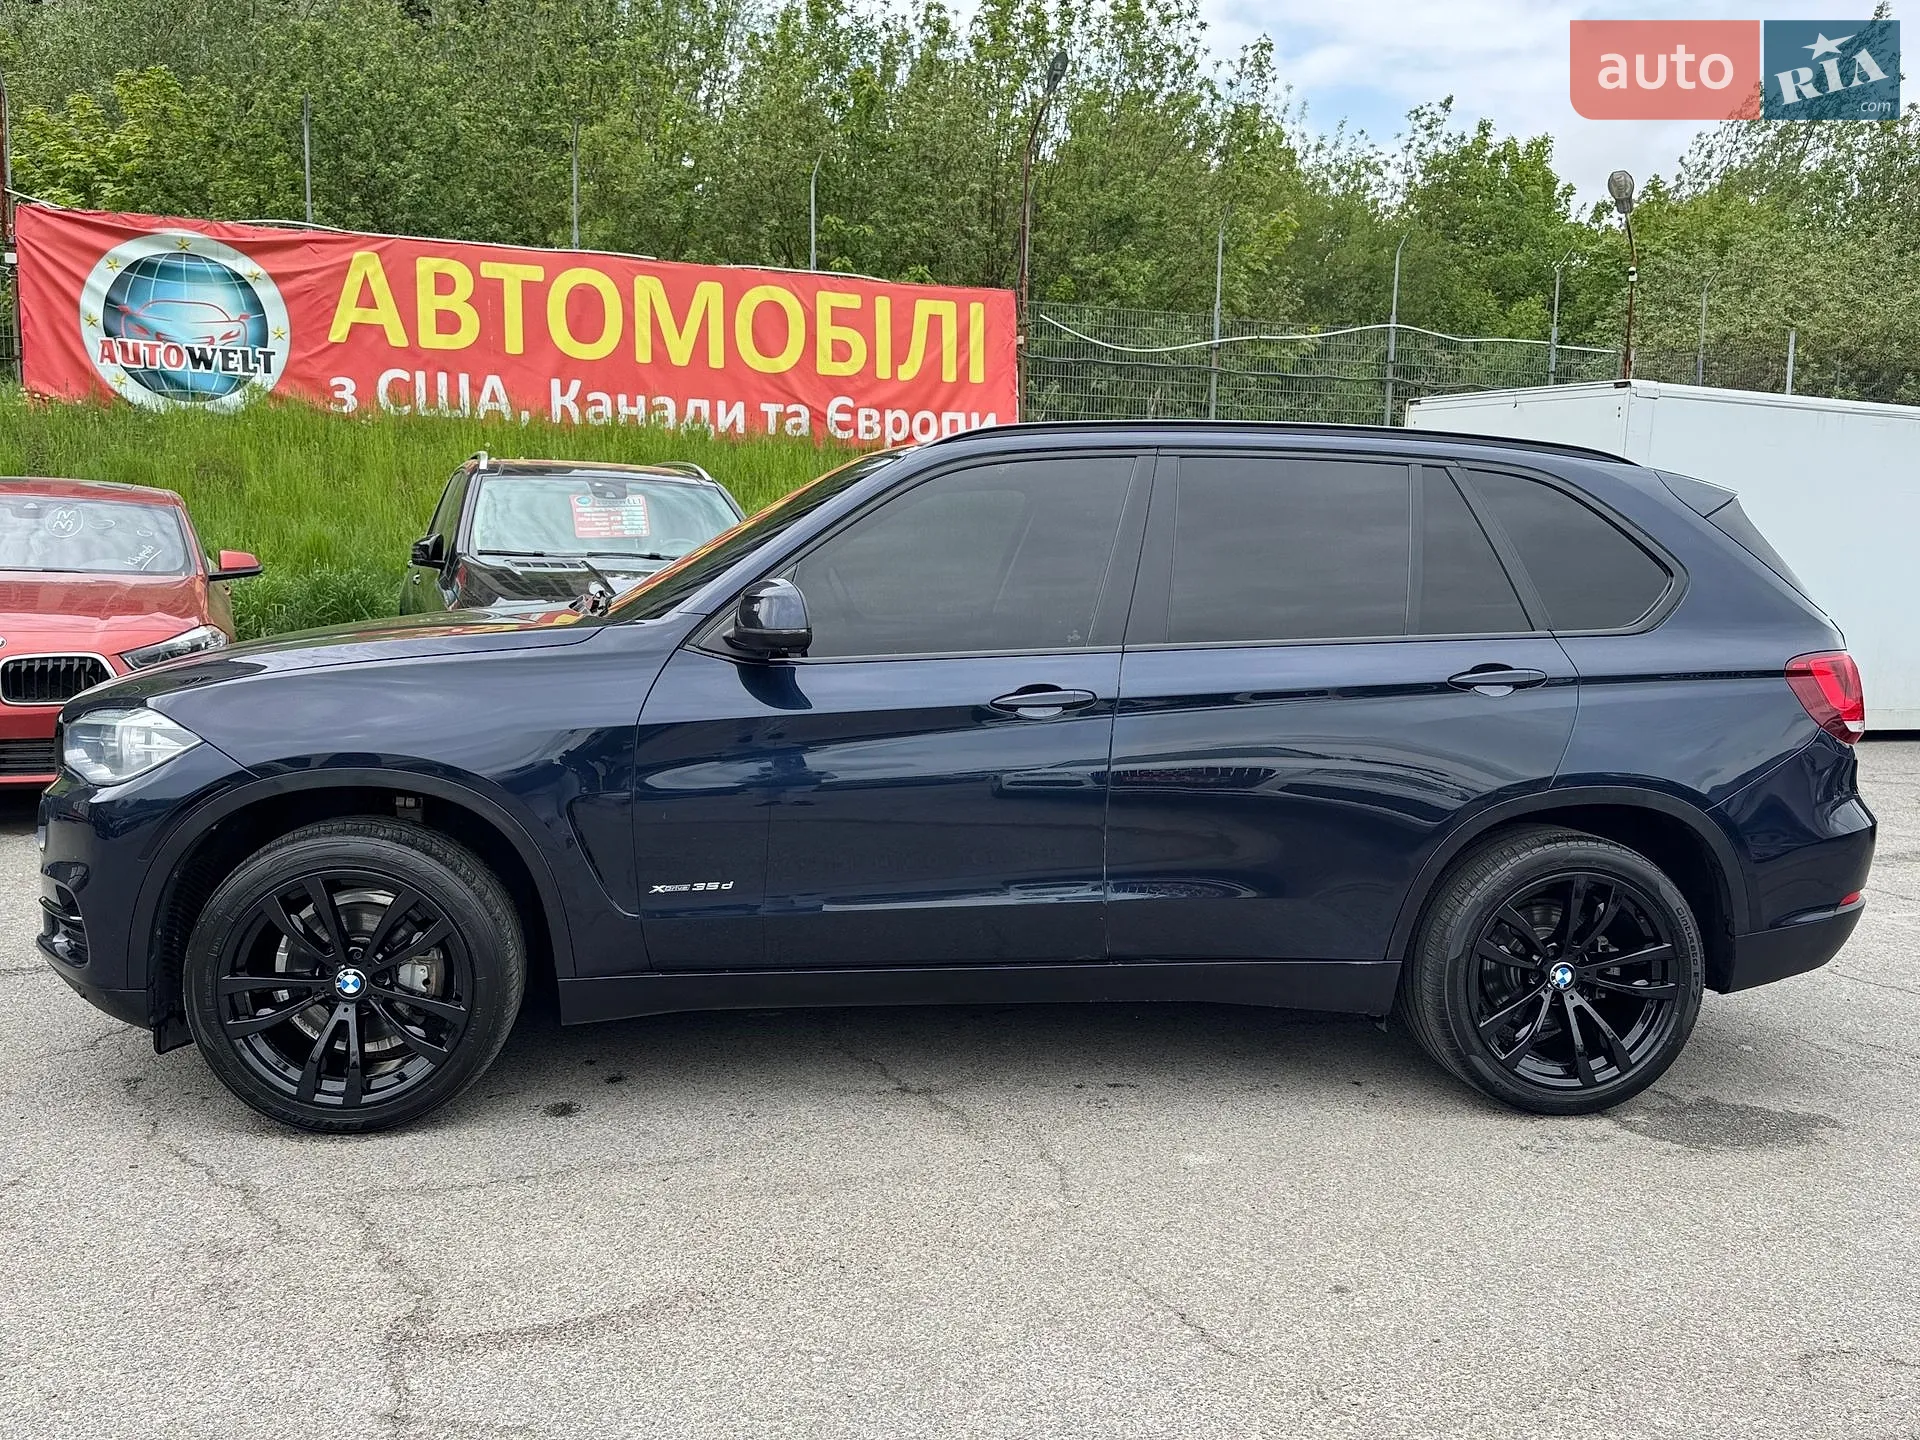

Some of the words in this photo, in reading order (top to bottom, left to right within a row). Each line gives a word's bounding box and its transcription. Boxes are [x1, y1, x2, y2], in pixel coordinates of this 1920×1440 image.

[327, 251, 985, 385] АВТОМОБІЛІ
[98, 337, 277, 376] AUTOWELT
[377, 368, 530, 427] США,
[550, 378, 746, 441] Канади
[760, 402, 811, 436] та
